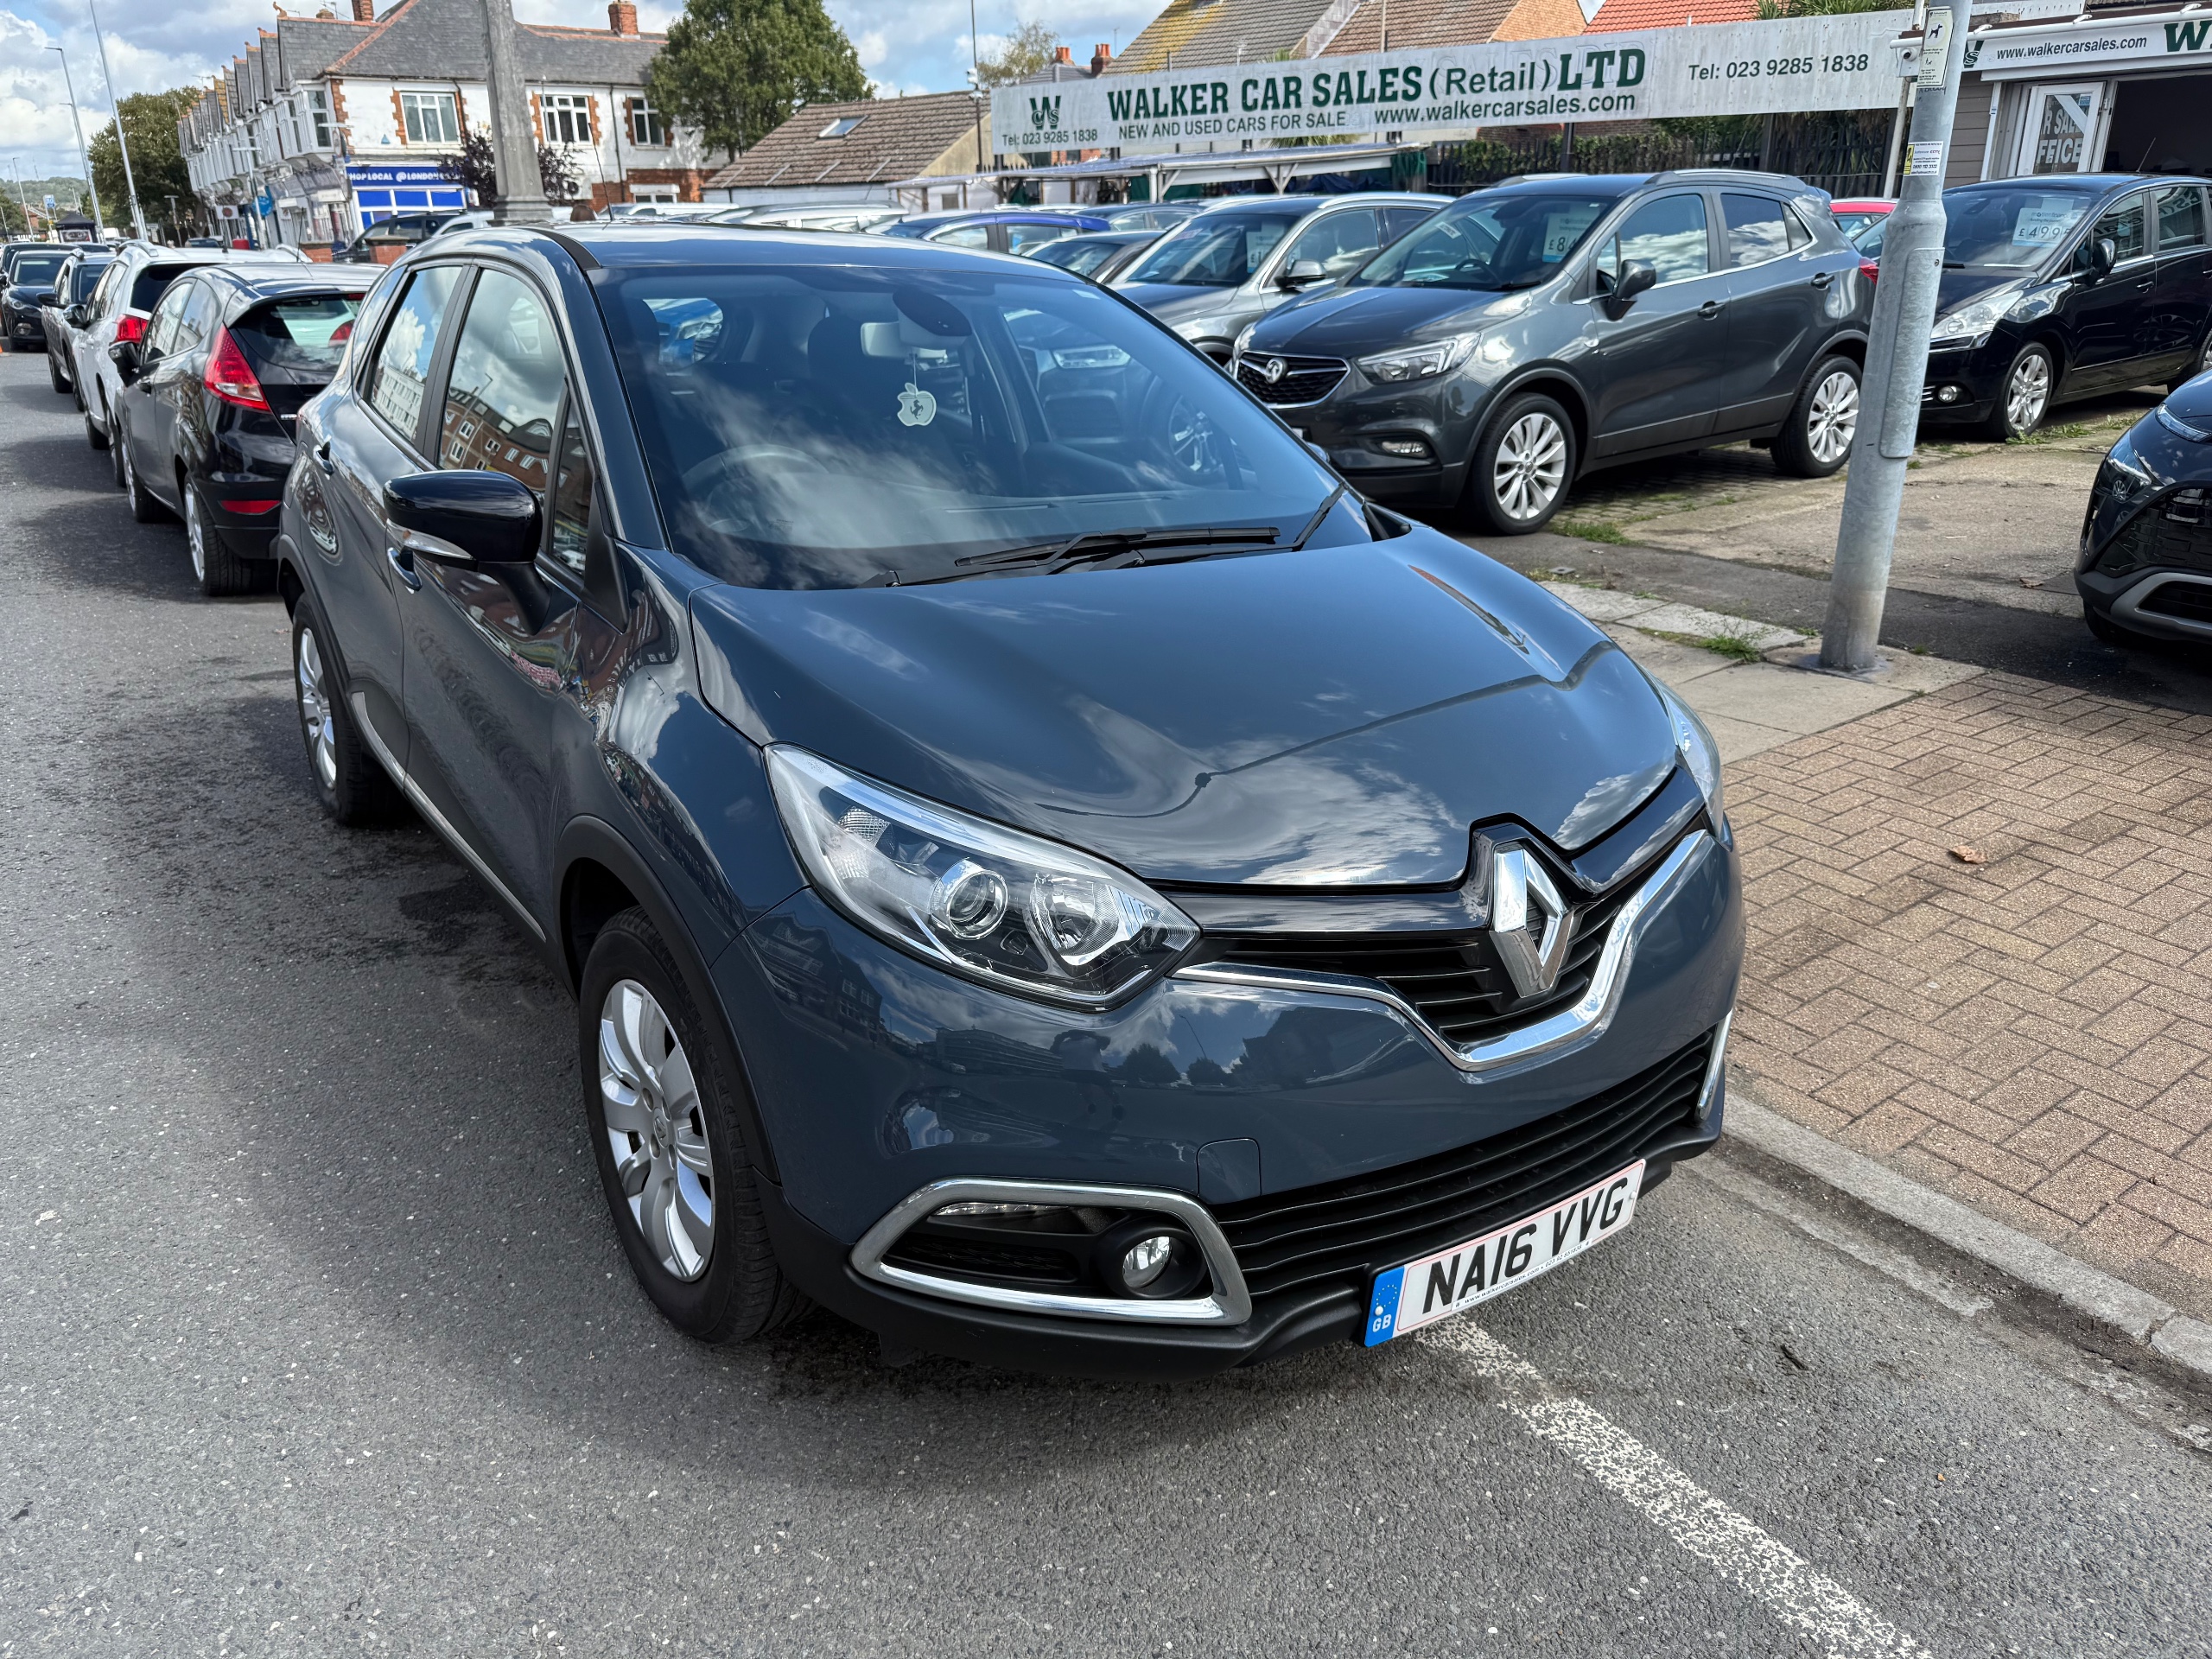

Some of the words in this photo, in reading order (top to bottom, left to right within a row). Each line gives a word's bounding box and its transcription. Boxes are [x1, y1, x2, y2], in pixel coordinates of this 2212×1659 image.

[1996, 36, 2148, 60] www.walkercarsales.com
[2163, 18, 2212, 53] W
[1688, 63, 1720, 81] Tel:
[1726, 60, 1761, 79] 023
[1765, 56, 1814, 76] 9285
[1820, 54, 1870, 73] 1838
[1107, 81, 1229, 122] WALKER
[1241, 75, 1302, 112] CAR
[1312, 66, 1423, 108] SALES
[1428, 59, 1552, 100] (Retail)
[1557, 48, 1646, 92] LTD
[1374, 93, 1636, 124] www.walkercarsales.com
[1001, 133, 1020, 147] Tel:
[1022, 131, 1042, 145] 023
[1043, 130, 1070, 143] 9285
[1072, 129, 1098, 142] 1838
[1118, 124, 1149, 140] NEW
[1151, 122, 1180, 138] AND
[1184, 119, 1223, 137] USED
[1226, 116, 1267, 133] CARS
[1270, 114, 1301, 130] FOR
[1305, 111, 1346, 128] SALE
[367, 172, 393, 181] LOCAL
[1421, 1223, 1538, 1315] NA16
[1551, 1176, 1629, 1257] VVG
[1372, 1313, 1392, 1333] GB
